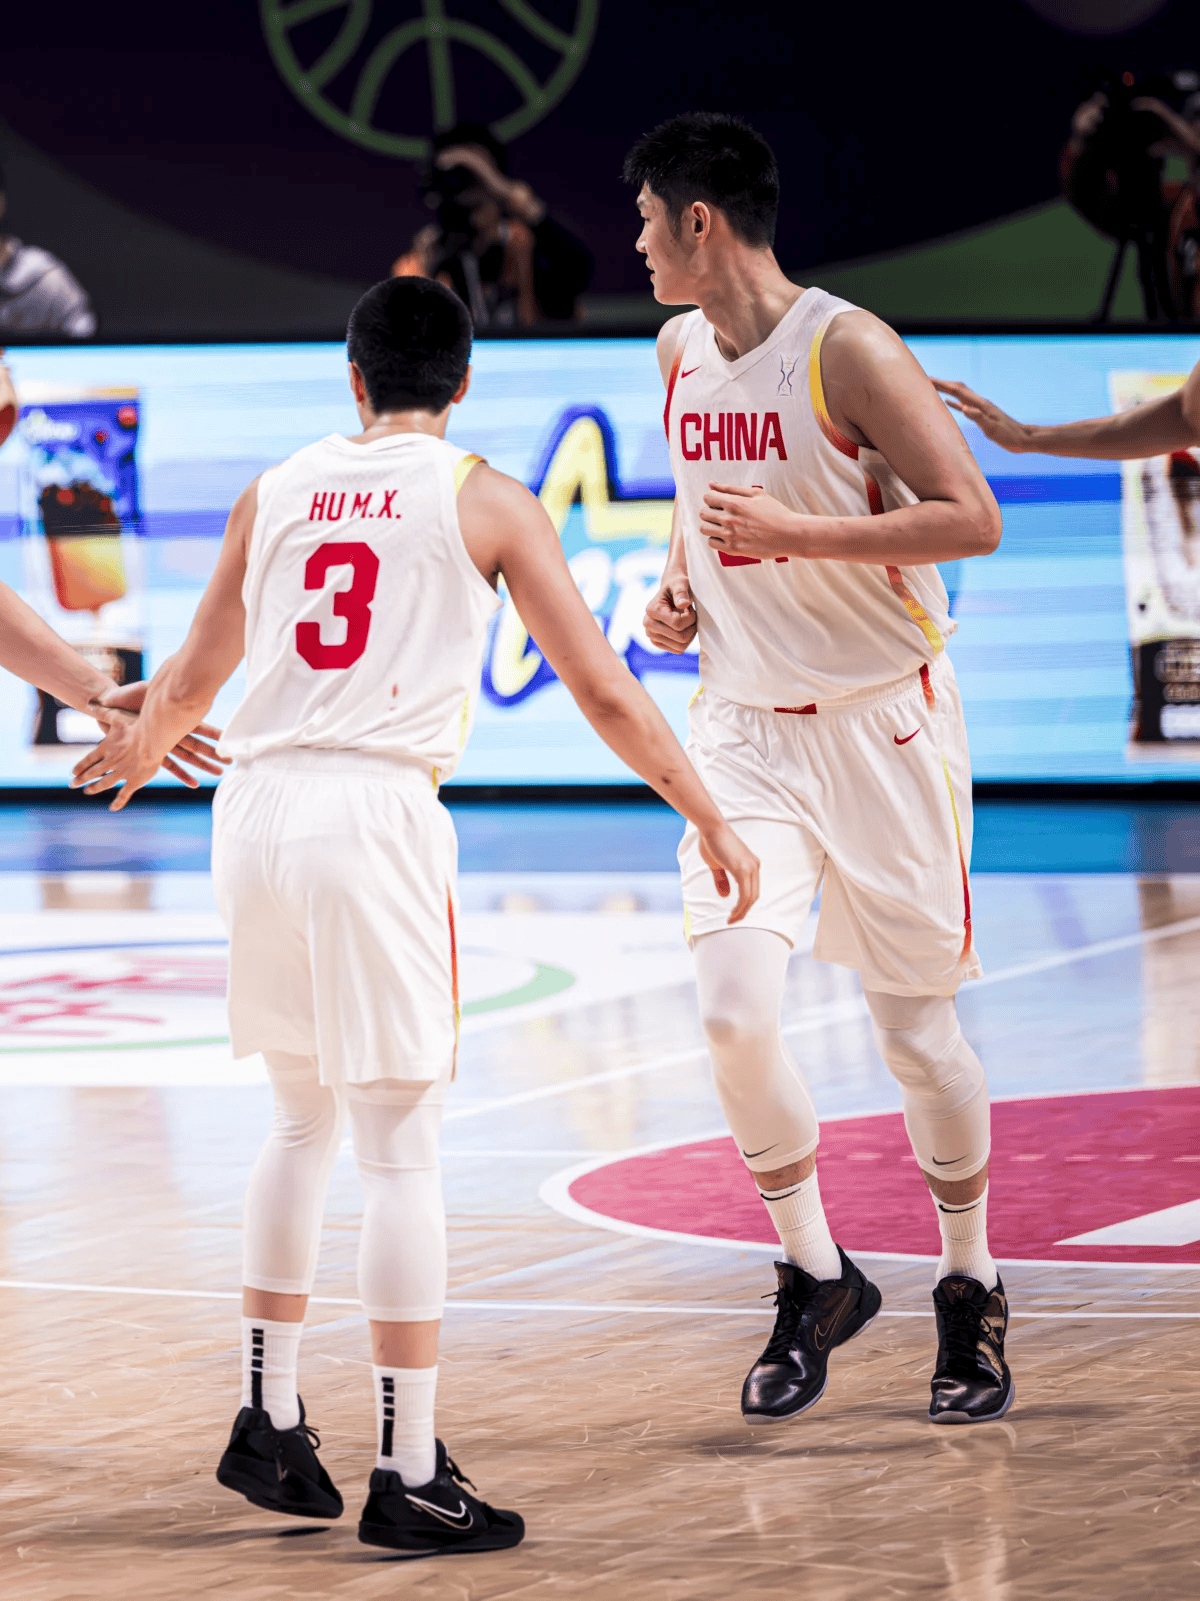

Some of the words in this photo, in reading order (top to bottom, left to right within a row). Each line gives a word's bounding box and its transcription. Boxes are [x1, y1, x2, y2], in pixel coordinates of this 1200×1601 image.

[680, 412, 788, 462] CHINA
[309, 492, 346, 521] HU
[350, 489, 402, 520] M.X.
[296, 542, 380, 670] 3
